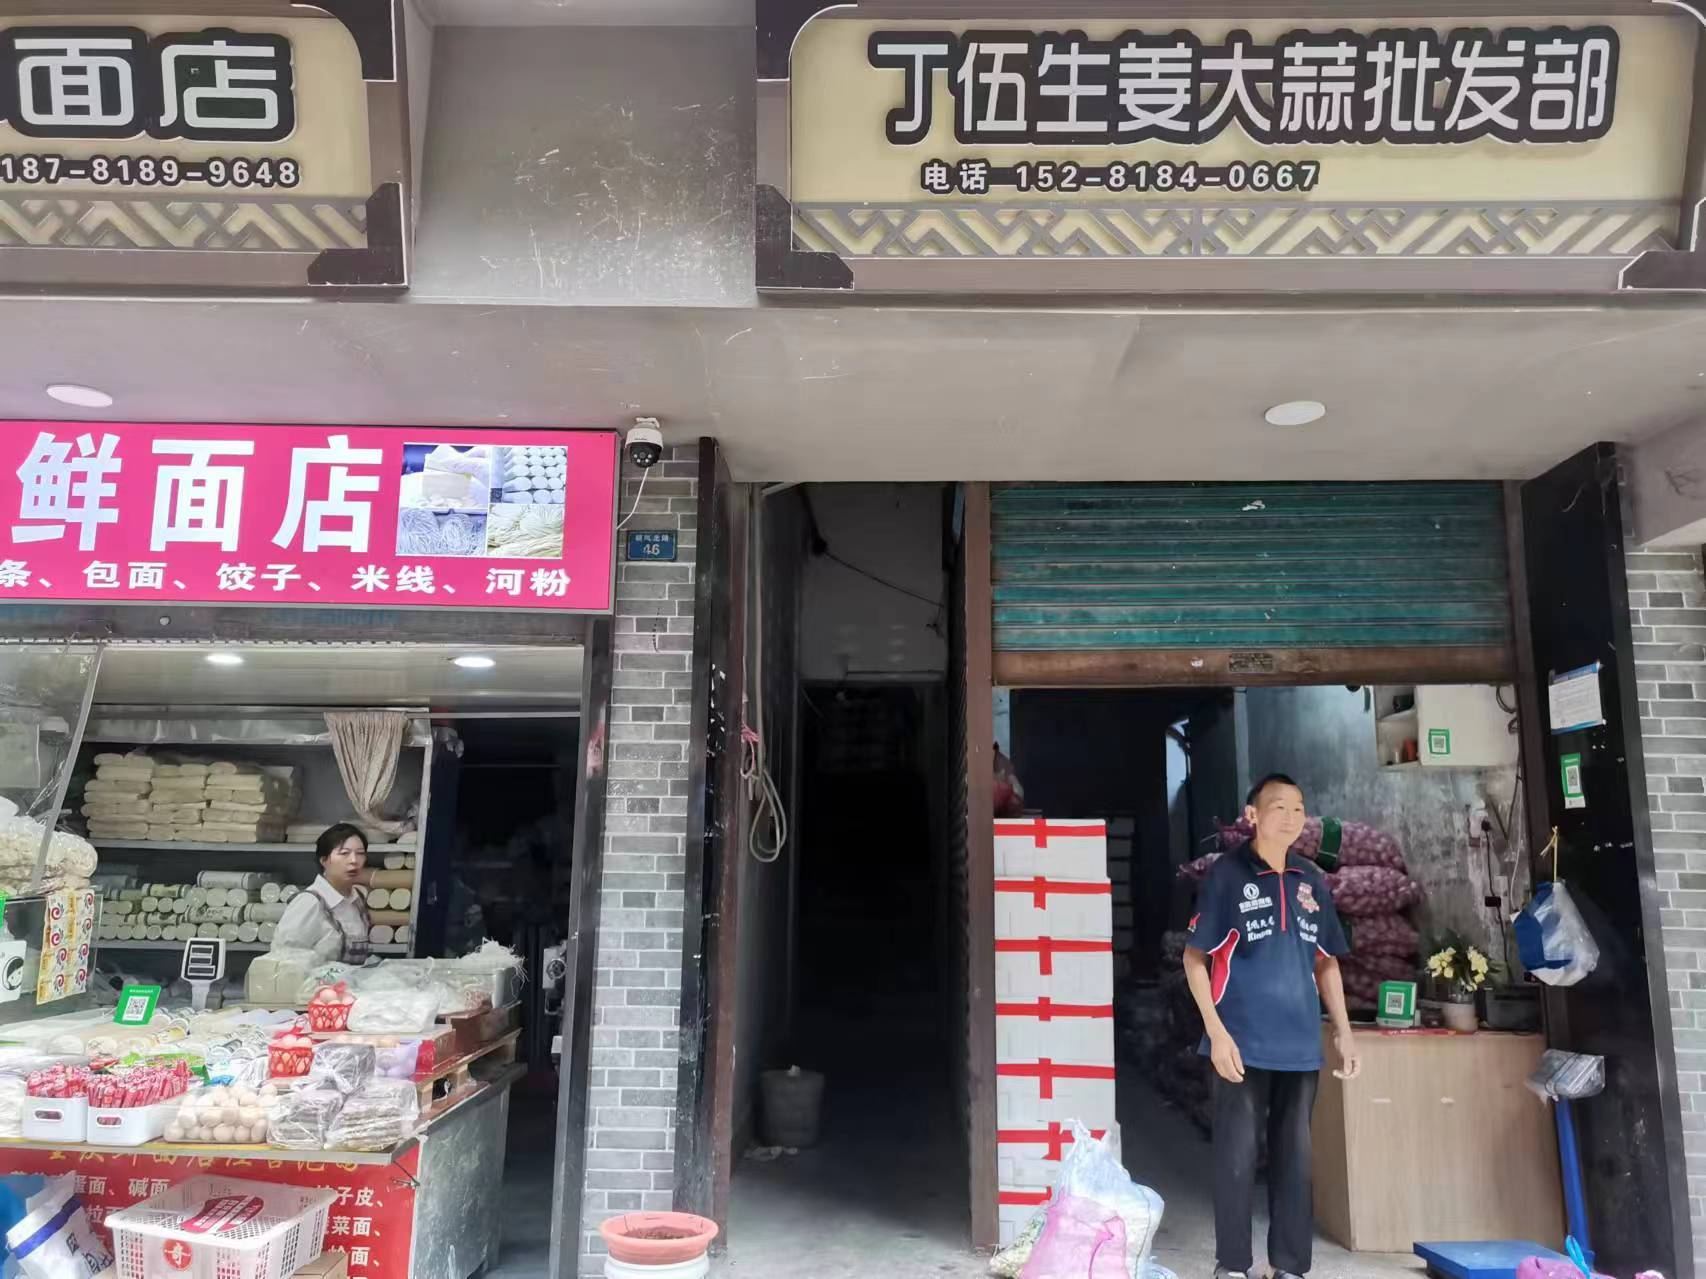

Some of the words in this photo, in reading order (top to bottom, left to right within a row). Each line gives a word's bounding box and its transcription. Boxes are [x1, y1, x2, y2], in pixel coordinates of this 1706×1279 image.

[13, 38, 277, 130] 面店
[876, 39, 1608, 134] 丁伍生姜大蒜批发部
[1, 157, 298, 186] 187-8189-9648
[921, 161, 988, 192] 电话
[1015, 162, 1320, 191] 152-8184-0667
[10, 430, 384, 554] 鲜面店
[643, 543, 660, 556] 46
